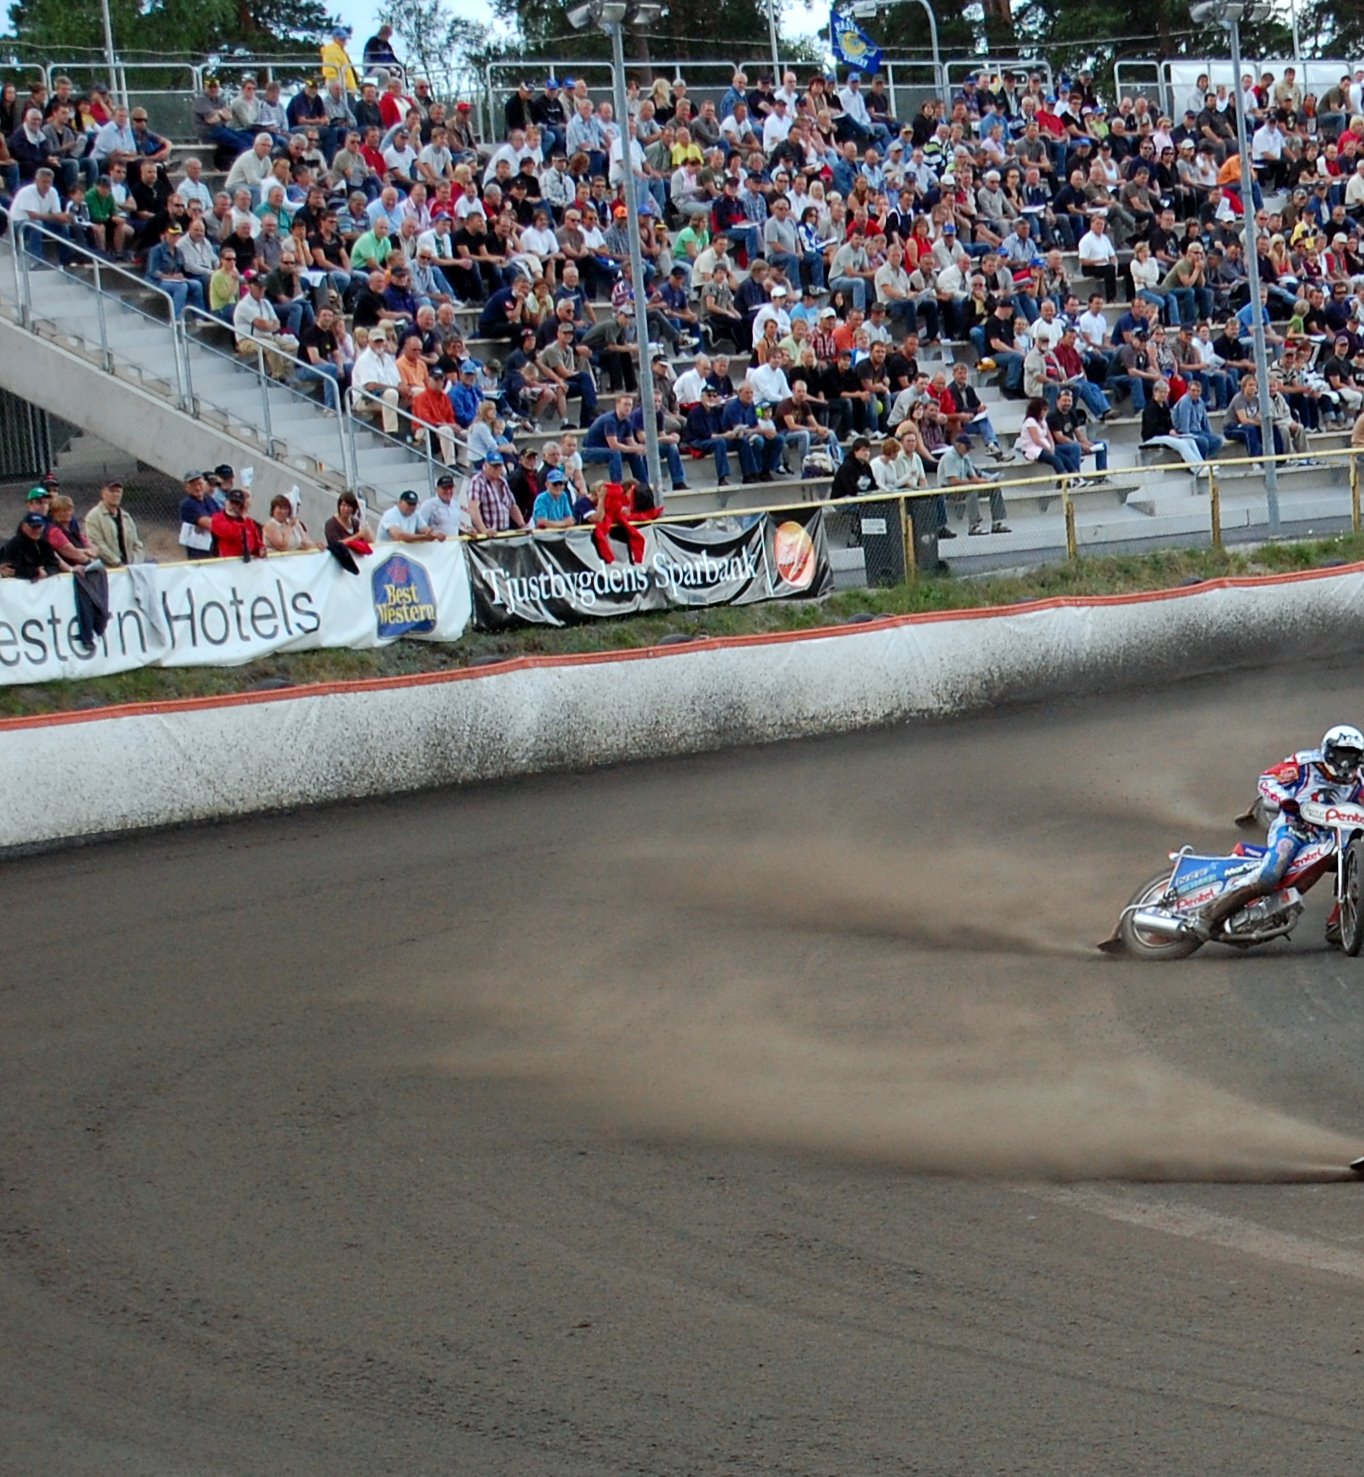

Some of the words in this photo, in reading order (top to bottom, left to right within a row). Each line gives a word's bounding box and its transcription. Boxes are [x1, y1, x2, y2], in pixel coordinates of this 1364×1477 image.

[384, 582, 419, 605] Best
[482, 559, 648, 615] Tjustbygdens
[652, 546, 758, 595] Sparbank
[161, 579, 321, 649] Hotels
[376, 603, 435, 624] Western
